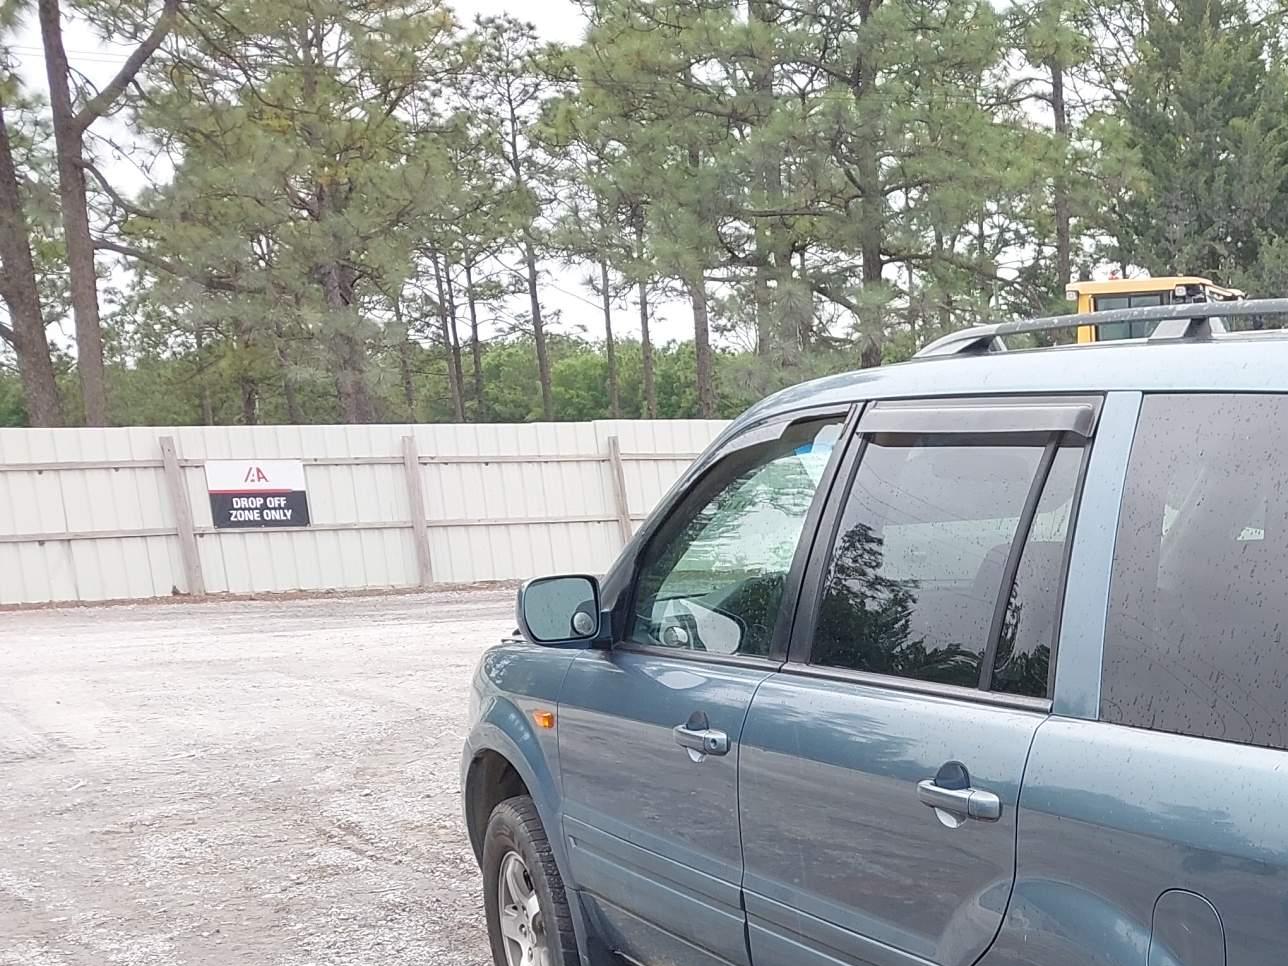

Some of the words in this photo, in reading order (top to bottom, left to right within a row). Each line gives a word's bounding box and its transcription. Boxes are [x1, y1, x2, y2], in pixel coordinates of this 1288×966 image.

[232, 497, 263, 508] DROP
[266, 496, 287, 508] OFF
[229, 510, 261, 521] ZONE
[263, 509, 292, 520] ONLY
